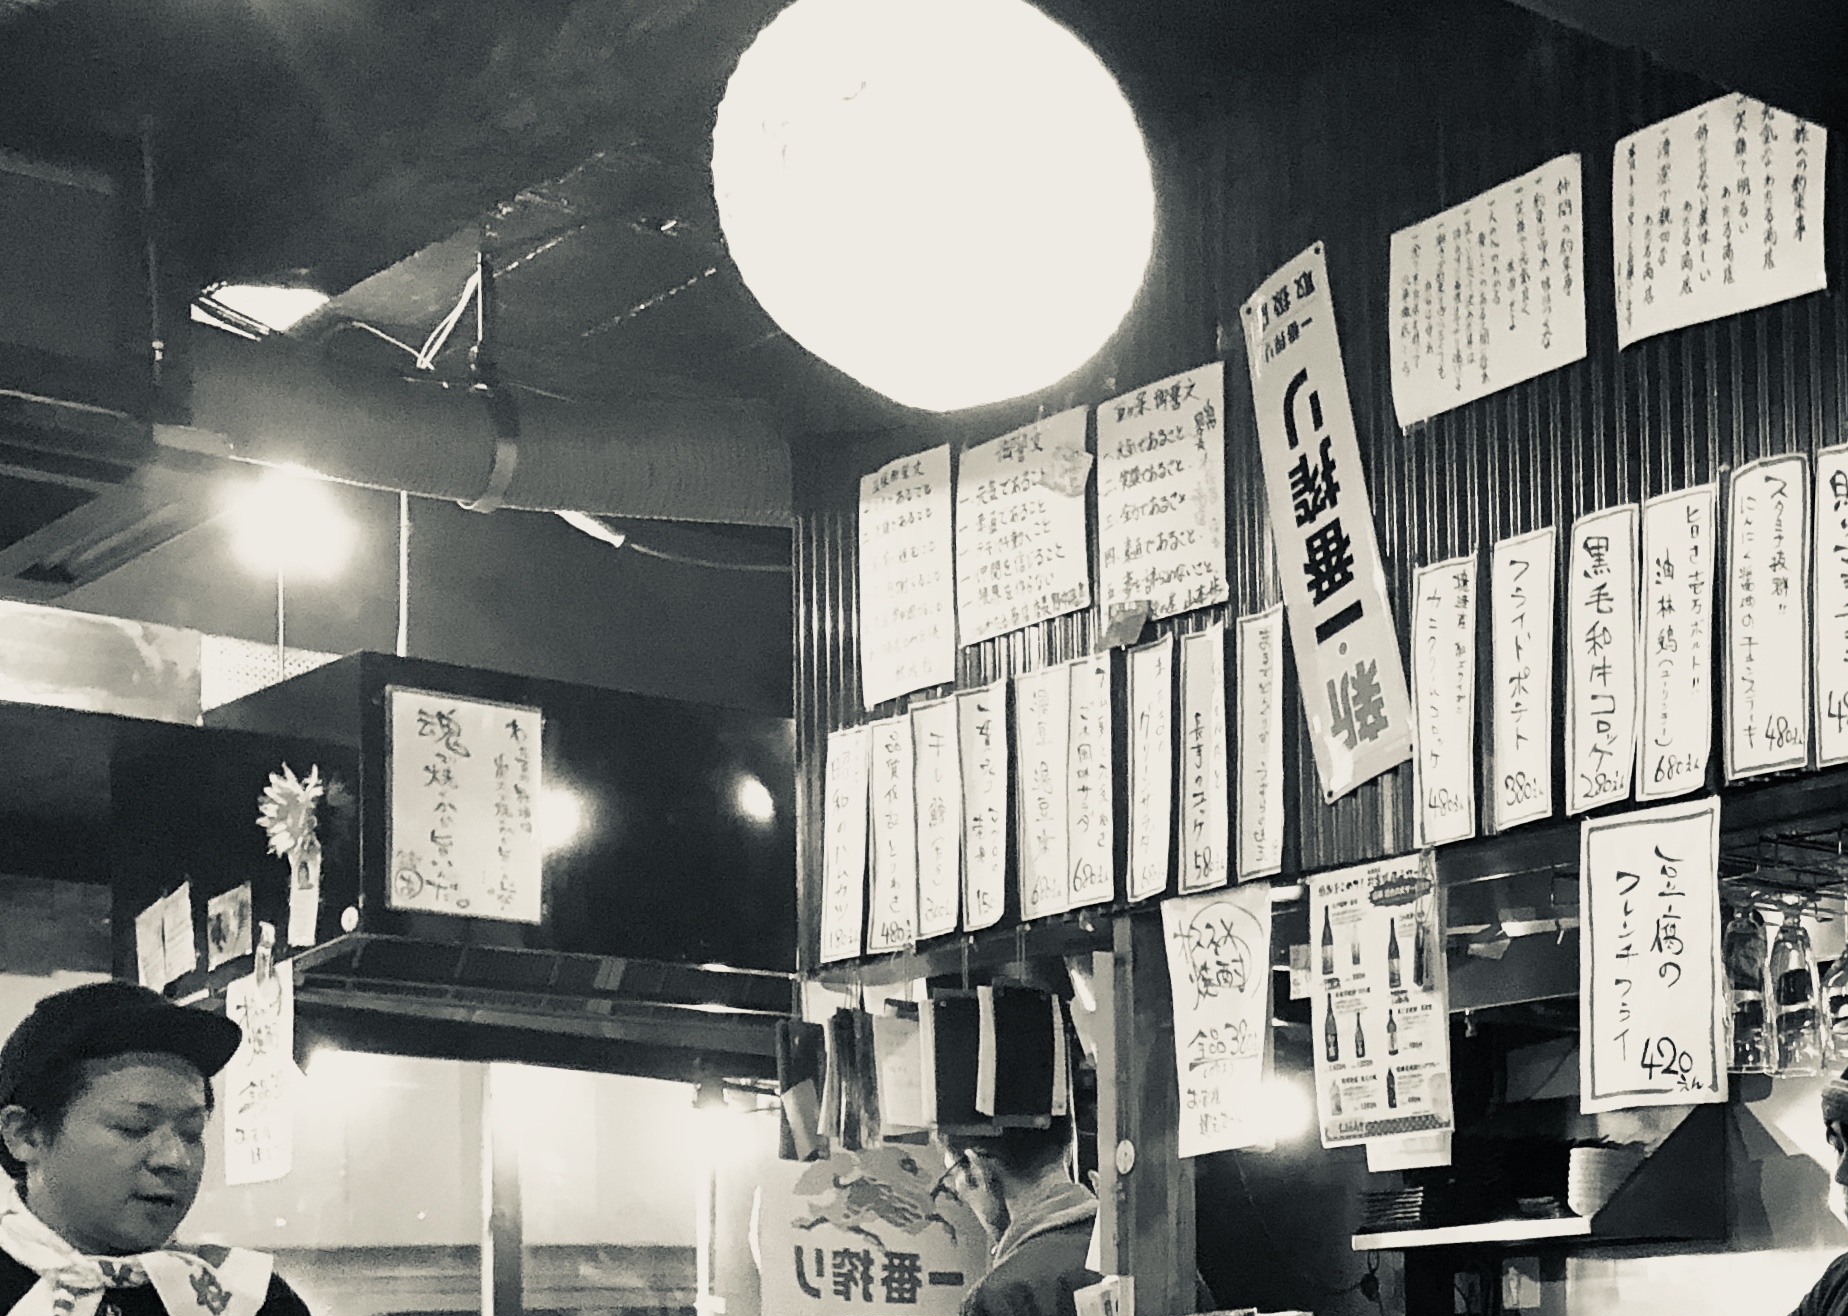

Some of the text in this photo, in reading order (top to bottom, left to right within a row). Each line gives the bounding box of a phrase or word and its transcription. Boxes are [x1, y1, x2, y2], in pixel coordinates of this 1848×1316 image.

[1509, 559, 1530, 752] フライドポテト
